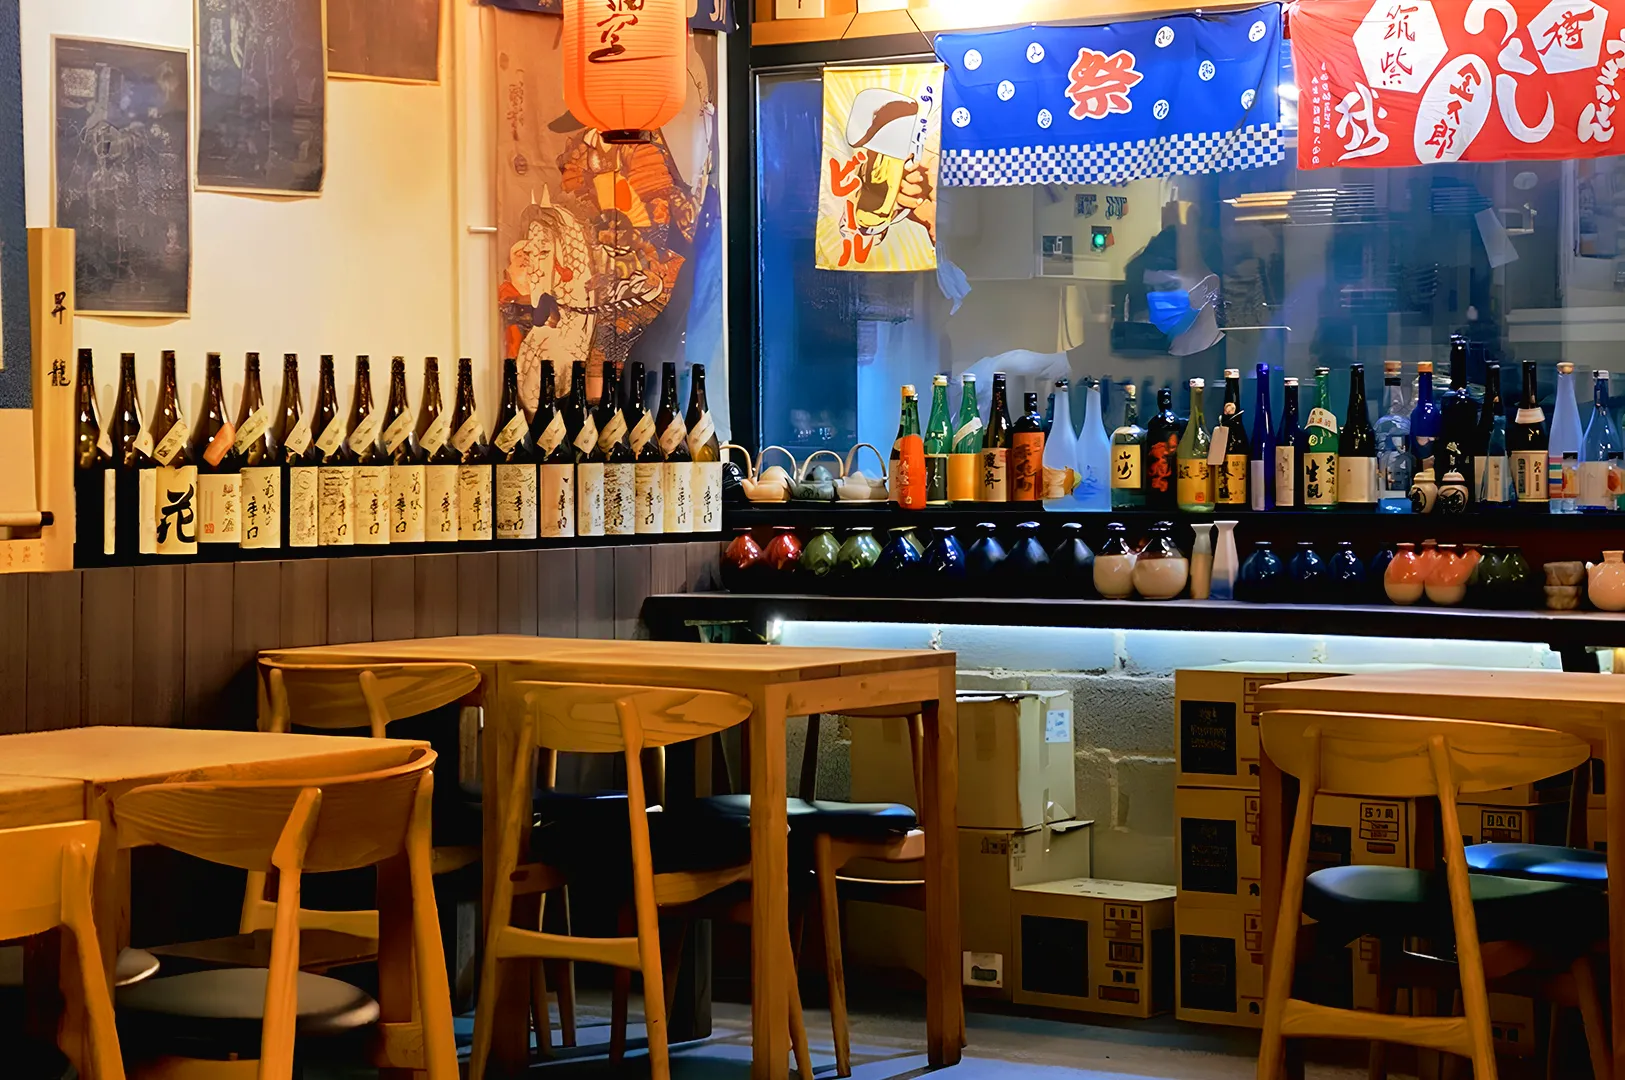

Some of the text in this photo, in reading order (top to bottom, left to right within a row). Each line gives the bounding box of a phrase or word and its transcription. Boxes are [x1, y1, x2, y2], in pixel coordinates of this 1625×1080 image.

[1066, 47, 1145, 120] 祭
[1381, 5, 1420, 86] 筑紫
[829, 151, 874, 267] ビール
[156, 483, 196, 544] 花
